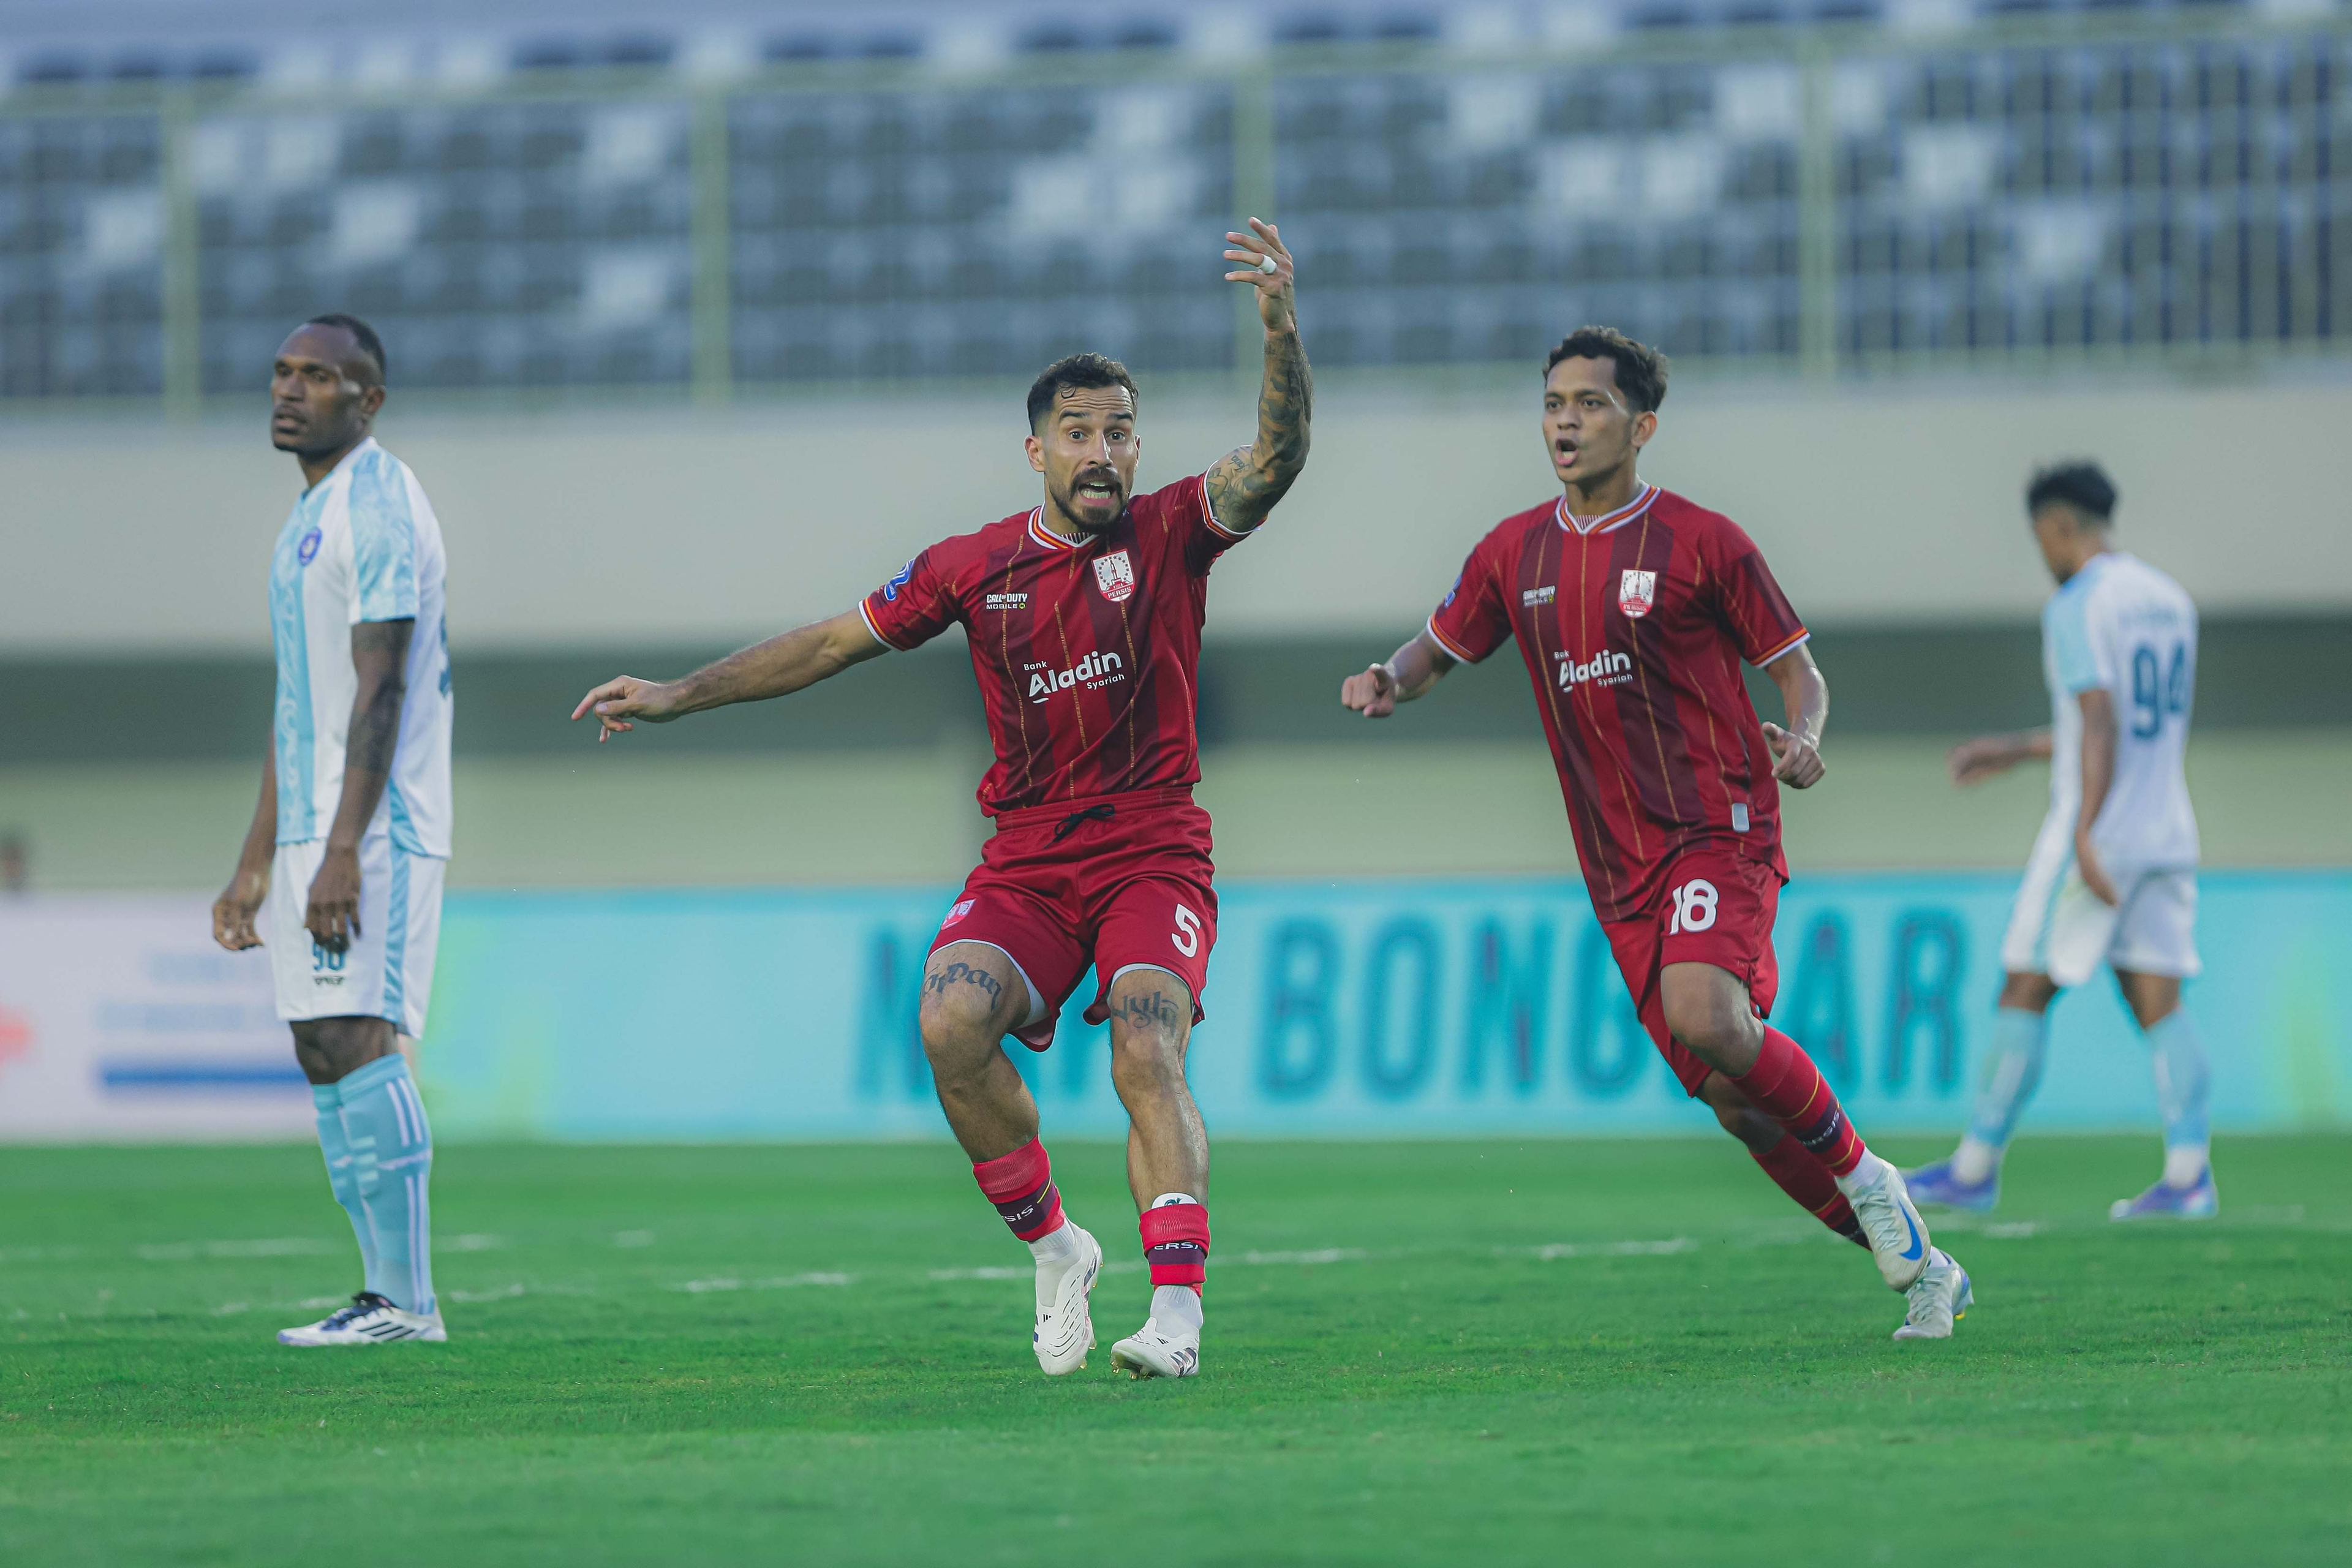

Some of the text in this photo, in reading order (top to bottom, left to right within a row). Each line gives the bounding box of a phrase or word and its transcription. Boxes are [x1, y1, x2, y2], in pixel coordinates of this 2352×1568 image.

[986, 594, 1002, 603] CALL
[1006, 593, 1028, 603] DUTY
[1107, 586, 1132, 598] PERSIS
[1023, 660, 1047, 671] Bank
[1028, 650, 1122, 697] Aladin
[1559, 649, 1631, 687] Aladin
[1087, 673, 1125, 690] Syariah
[1597, 673, 1633, 688] Syariah
[1669, 878, 1719, 935] 18
[1171, 903, 1201, 958] 5
[1257, 911, 1969, 1102] BONGAR
